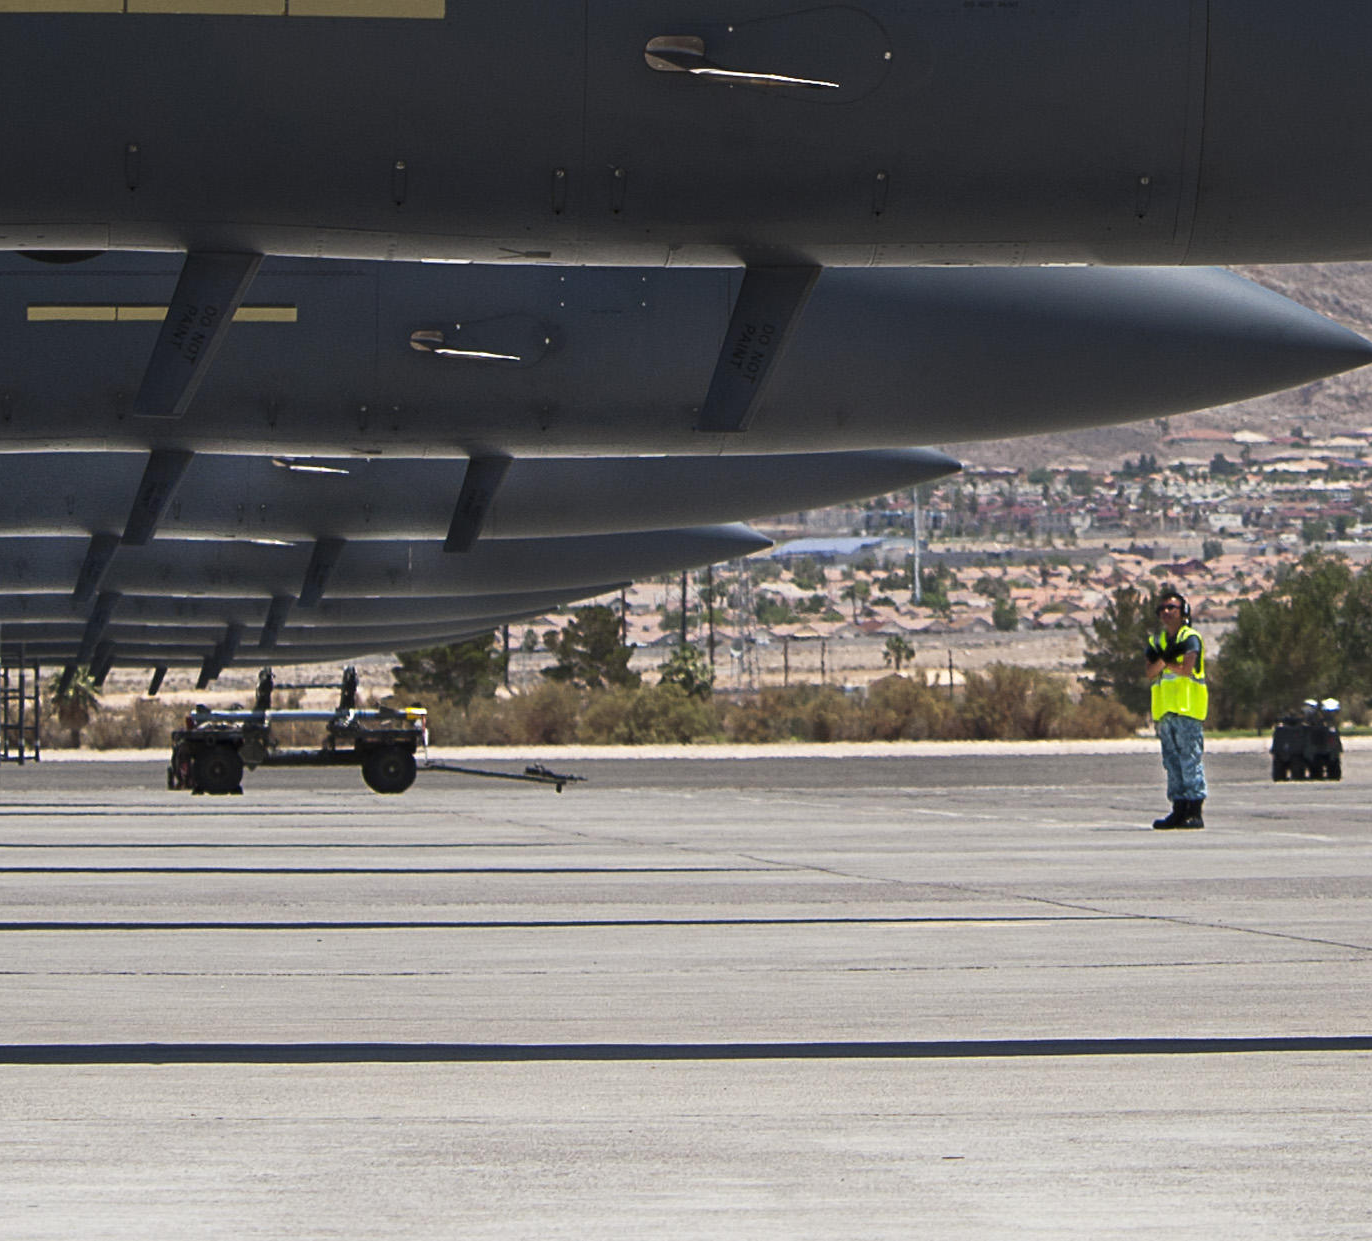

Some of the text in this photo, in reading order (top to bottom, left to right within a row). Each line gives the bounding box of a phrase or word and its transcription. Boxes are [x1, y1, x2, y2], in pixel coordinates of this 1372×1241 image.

[172, 303, 198, 351] PAINT
[183, 304, 217, 365] DO NOT
[729, 322, 756, 369] PAINT
[741, 323, 775, 384] DO NOT
